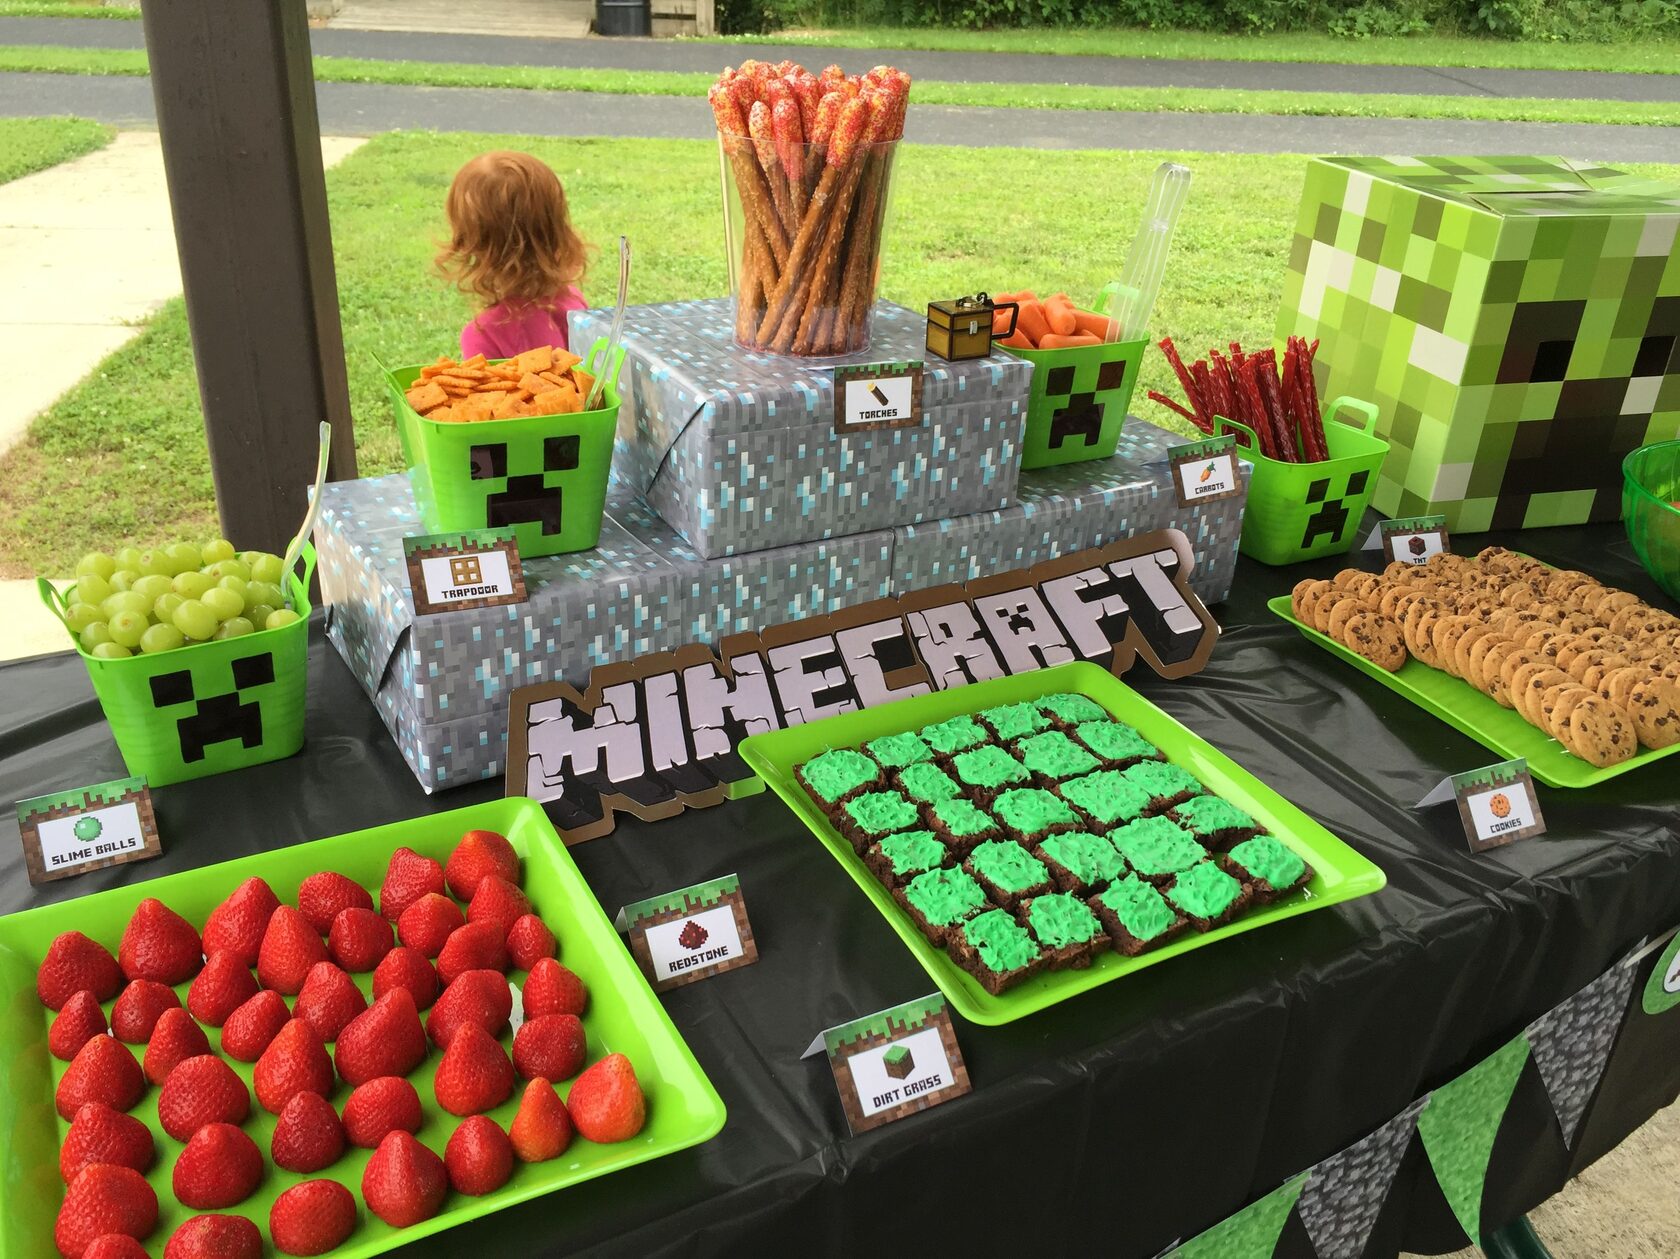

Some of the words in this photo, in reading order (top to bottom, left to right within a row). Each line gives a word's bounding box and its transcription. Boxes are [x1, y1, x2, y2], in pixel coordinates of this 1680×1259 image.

[859, 409, 898, 419] TORCHES
[1195, 482, 1225, 494] CARROTS
[442, 585, 499, 599] TRAPDOOR
[526, 549, 1203, 803] MINECRAFT
[1490, 818, 1522, 833] COOKIES
[52, 848, 92, 865] SLIME
[95, 838, 136, 855] BALLS
[669, 946, 729, 972] REDSTONE
[873, 1089, 900, 1108] DIRT
[903, 1074, 941, 1097] GRASS
